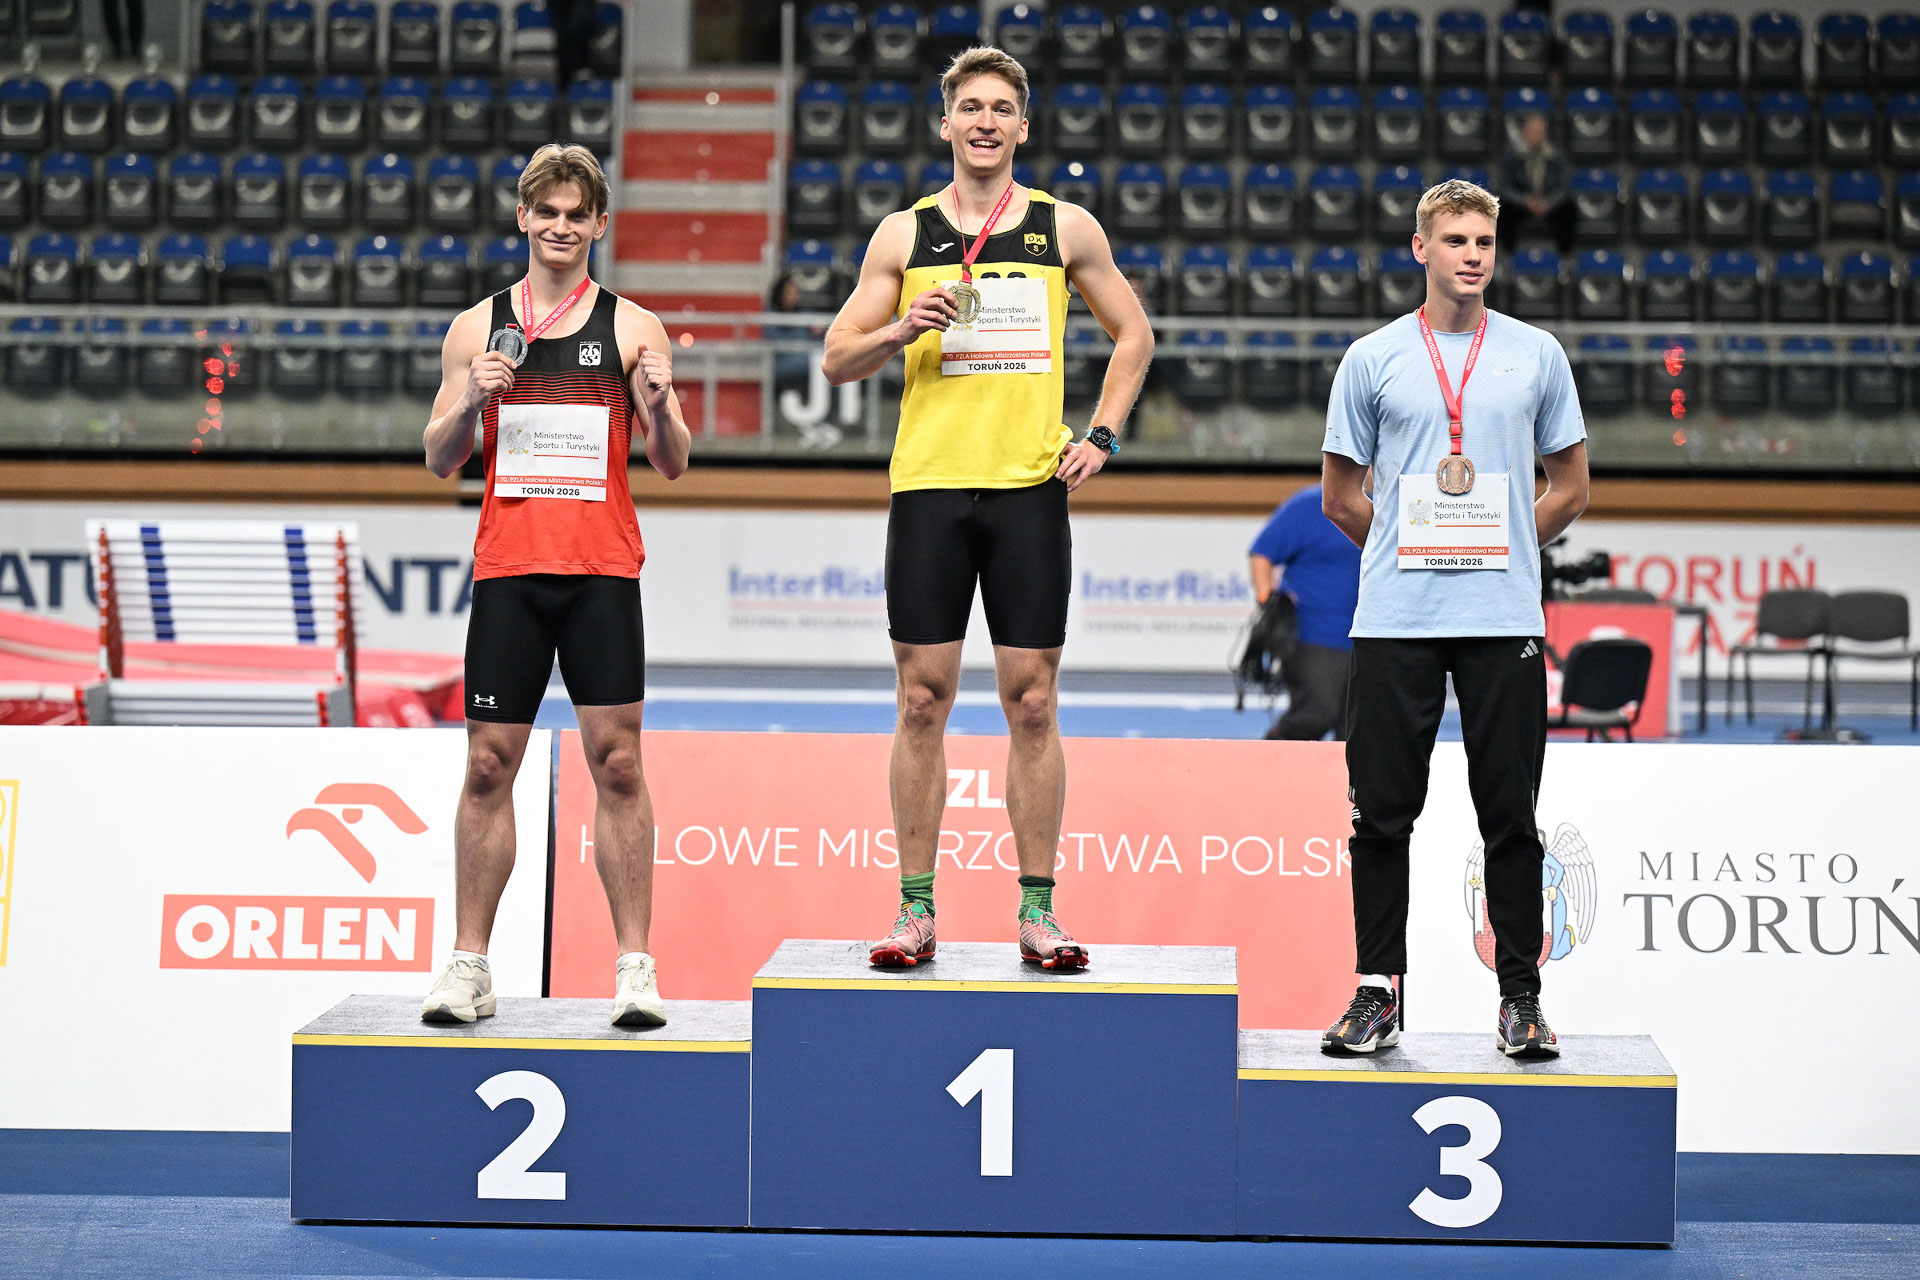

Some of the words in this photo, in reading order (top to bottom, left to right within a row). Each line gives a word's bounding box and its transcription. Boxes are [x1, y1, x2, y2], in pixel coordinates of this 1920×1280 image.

[979, 306, 1026, 314] Ministerstwo
[977, 316, 1003, 325] Sportu
[1009, 315, 1041, 324] Turystyki
[968, 361, 1002, 371] TORUŃ
[1003, 362, 1027, 370] 2026
[534, 432, 585, 441] Ministerstwo
[533, 442, 559, 451] Sportu
[566, 442, 600, 452] Turystyki
[548, 477, 585, 485] Mistrzostwa
[521, 486, 555, 495] TORUŃ
[556, 488, 580, 496] 2026
[1434, 502, 1485, 510] Ministerstwo
[1434, 511, 1461, 521] Sportu
[1467, 511, 1501, 521] Turystyki
[1424, 556, 1458, 566] TORUŃ
[1459, 558, 1483, 566] 2026
[1638, 851, 1858, 883] MIASTO
[1623, 878, 1920, 956] TORUŃ
[175, 904, 417, 960] ORLEN
[945, 1048, 1014, 1176] 1
[475, 1071, 567, 1199] 2
[1408, 1096, 1504, 1228] 3
